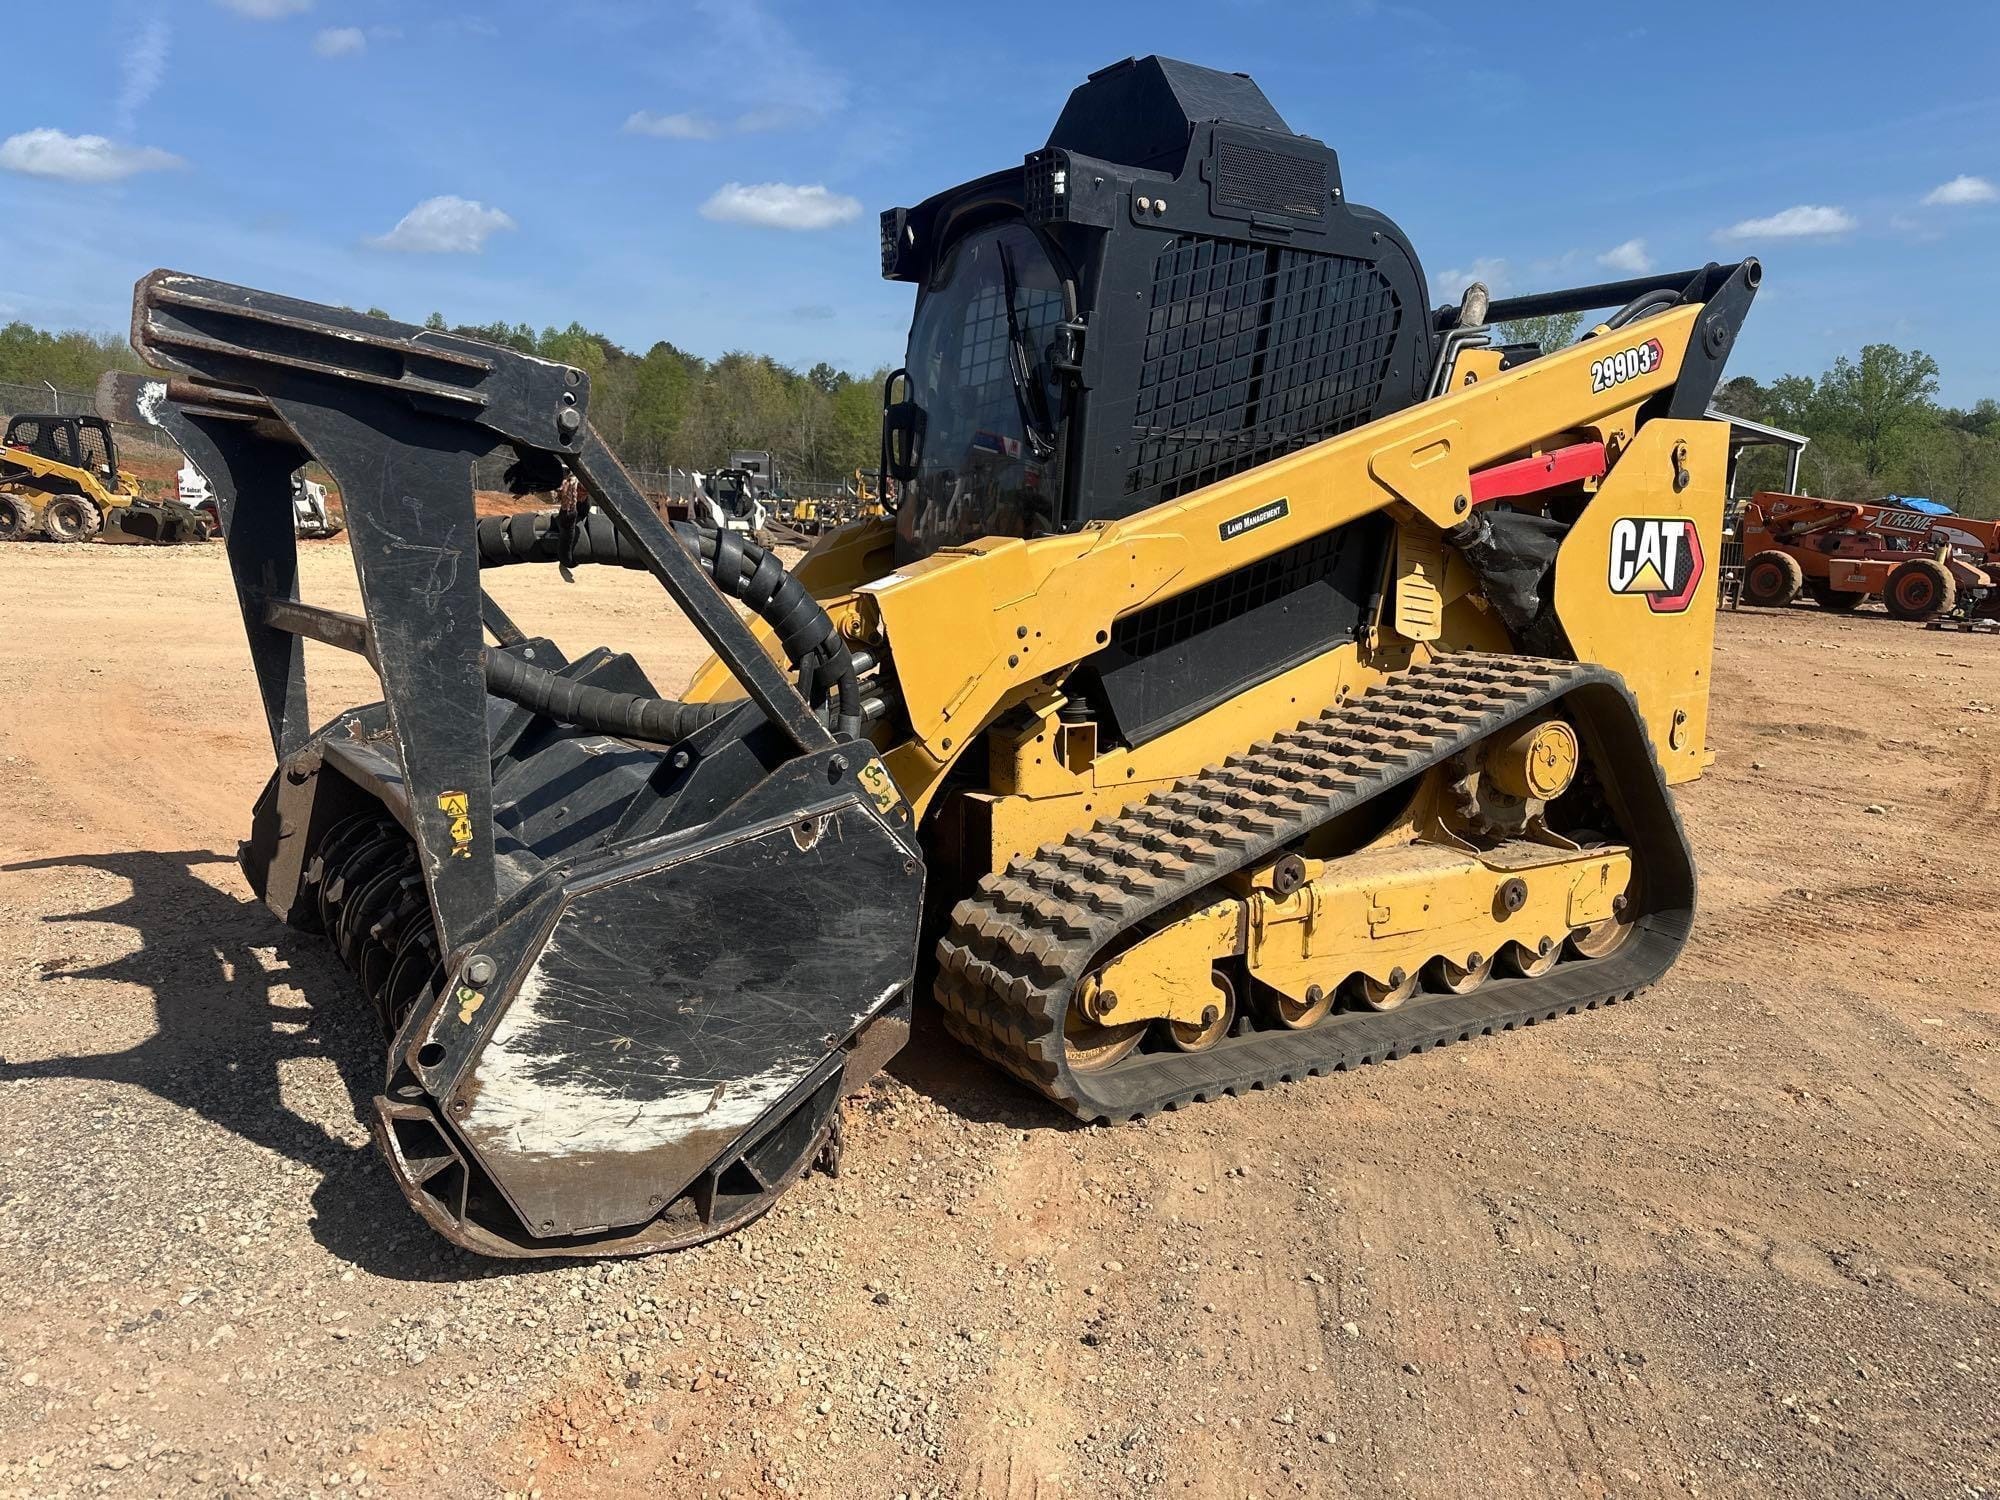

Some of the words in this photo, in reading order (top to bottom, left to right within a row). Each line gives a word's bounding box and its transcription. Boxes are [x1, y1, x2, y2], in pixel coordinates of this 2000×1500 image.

[1591, 343, 1651, 393] 299D3
[1866, 510, 1936, 531] XTREME
[1609, 519, 1684, 592] CAT
